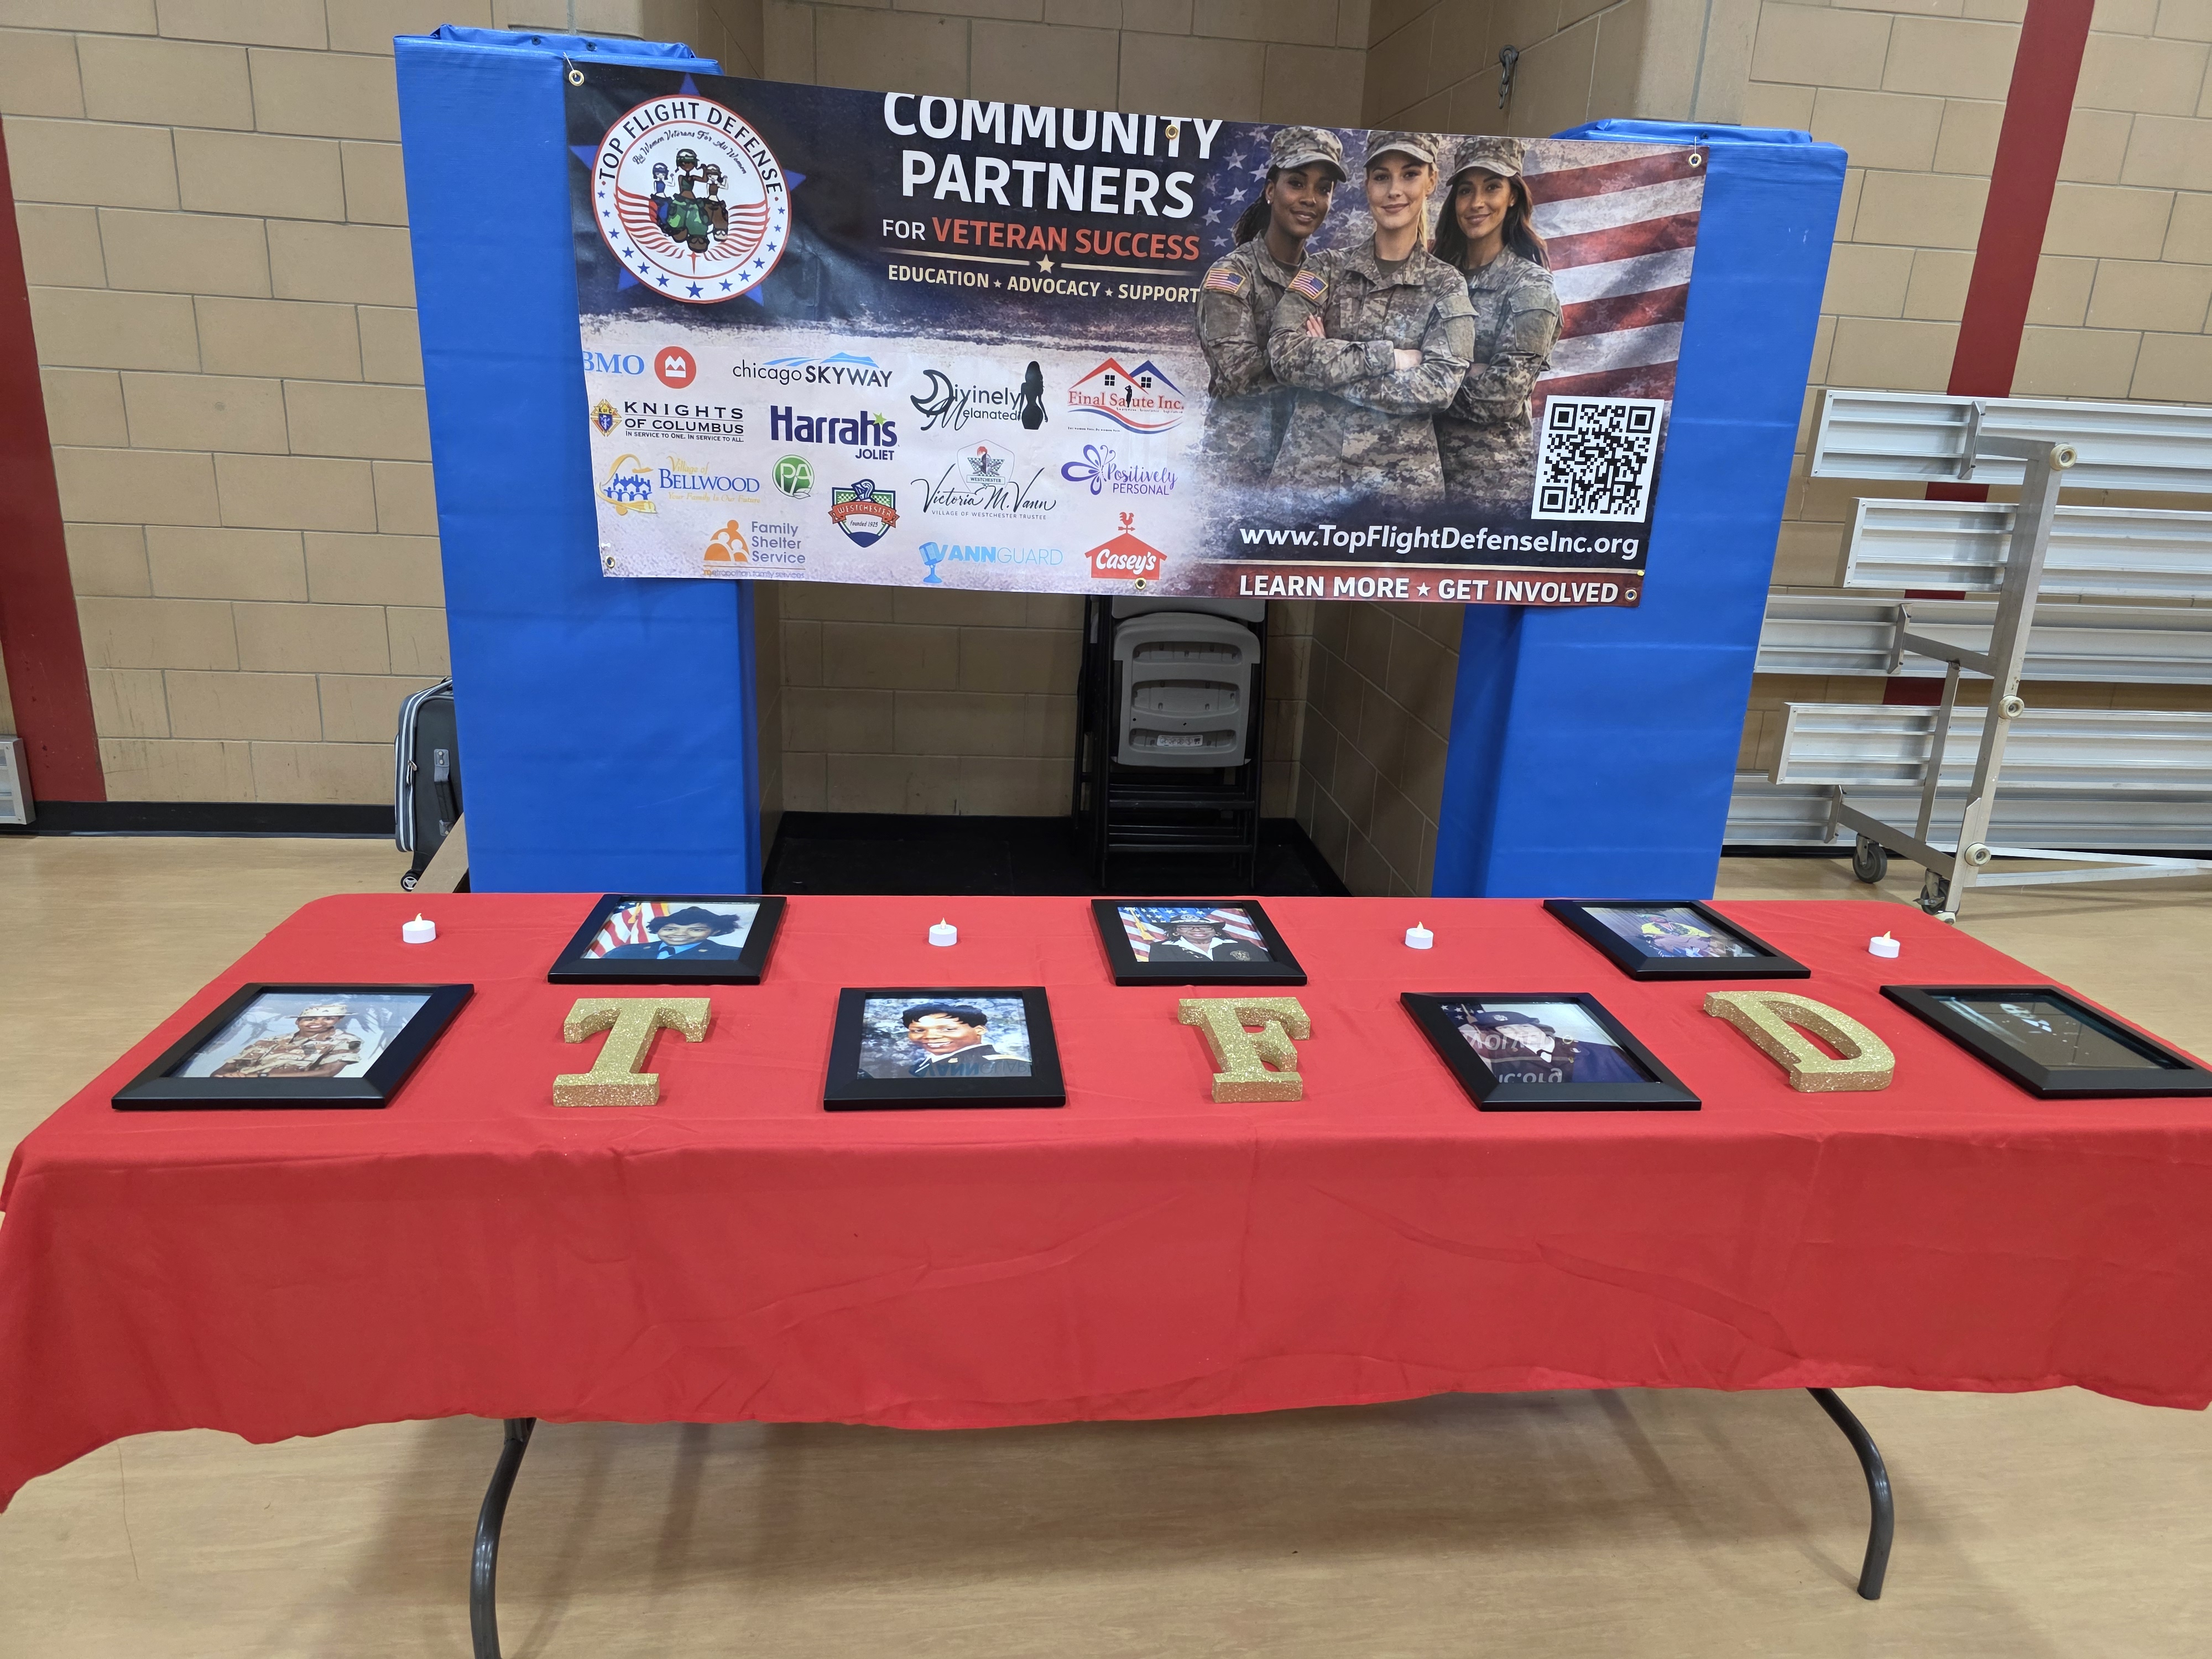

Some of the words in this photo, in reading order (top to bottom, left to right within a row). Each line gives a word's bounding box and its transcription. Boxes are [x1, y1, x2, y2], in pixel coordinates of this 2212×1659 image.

[697, 131, 712, 142] For
[884, 92, 1223, 159] COMMUNITY
[599, 137, 624, 180] TOP
[623, 102, 700, 139] FLIGHT
[707, 107, 782, 194] DEFENSE
[902, 150, 1194, 218] PARTNERS
[883, 220, 925, 241] FOR
[932, 217, 1067, 252] VETERAN
[1075, 229, 1199, 261] SUCCESS
[889, 265, 989, 288] EDUCATION
[1007, 276, 1100, 297] ADVOCACY
[1118, 284, 1200, 304] SUPPORT
[583, 351, 644, 375] BMO
[733, 359, 802, 385] chicago
[805, 366, 893, 387] SKYWAY
[624, 401, 743, 419] KNIGHTS
[1068, 391, 1105, 405] Final
[1157, 395, 1185, 409] Inc.
[625, 418, 646, 429] OF
[652, 420, 744, 434] COLUMBUS
[666, 456, 698, 474] Village
[701, 462, 709, 475] of
[855, 448, 895, 461] JOLIET
[658, 468, 760, 492] BELLWOOD
[911, 463, 984, 513] Victoria
[1007, 467, 1057, 513] Vann
[1108, 463, 1178, 490] Positively
[687, 492, 710, 502] Family
[1113, 483, 1170, 495] PERSONAL
[837, 504, 892, 517] WESTCHESTER
[752, 521, 799, 537] Family
[752, 536, 801, 549] Shelter
[1240, 524, 1639, 560] www.TopFlightDefenseInc.org
[752, 551, 806, 564] Service
[931, 544, 1063, 565] VANNGUARD
[1096, 549, 1156, 575] Casey's
[1240, 575, 1324, 597] LEARN
[1333, 576, 1408, 599] MORE
[1438, 578, 1489, 601] GET
[1496, 581, 1619, 604] INVOLVED
[553, 998, 711, 1107] T
[1178, 997, 1311, 1103] F
[1703, 991, 1895, 1092] D
